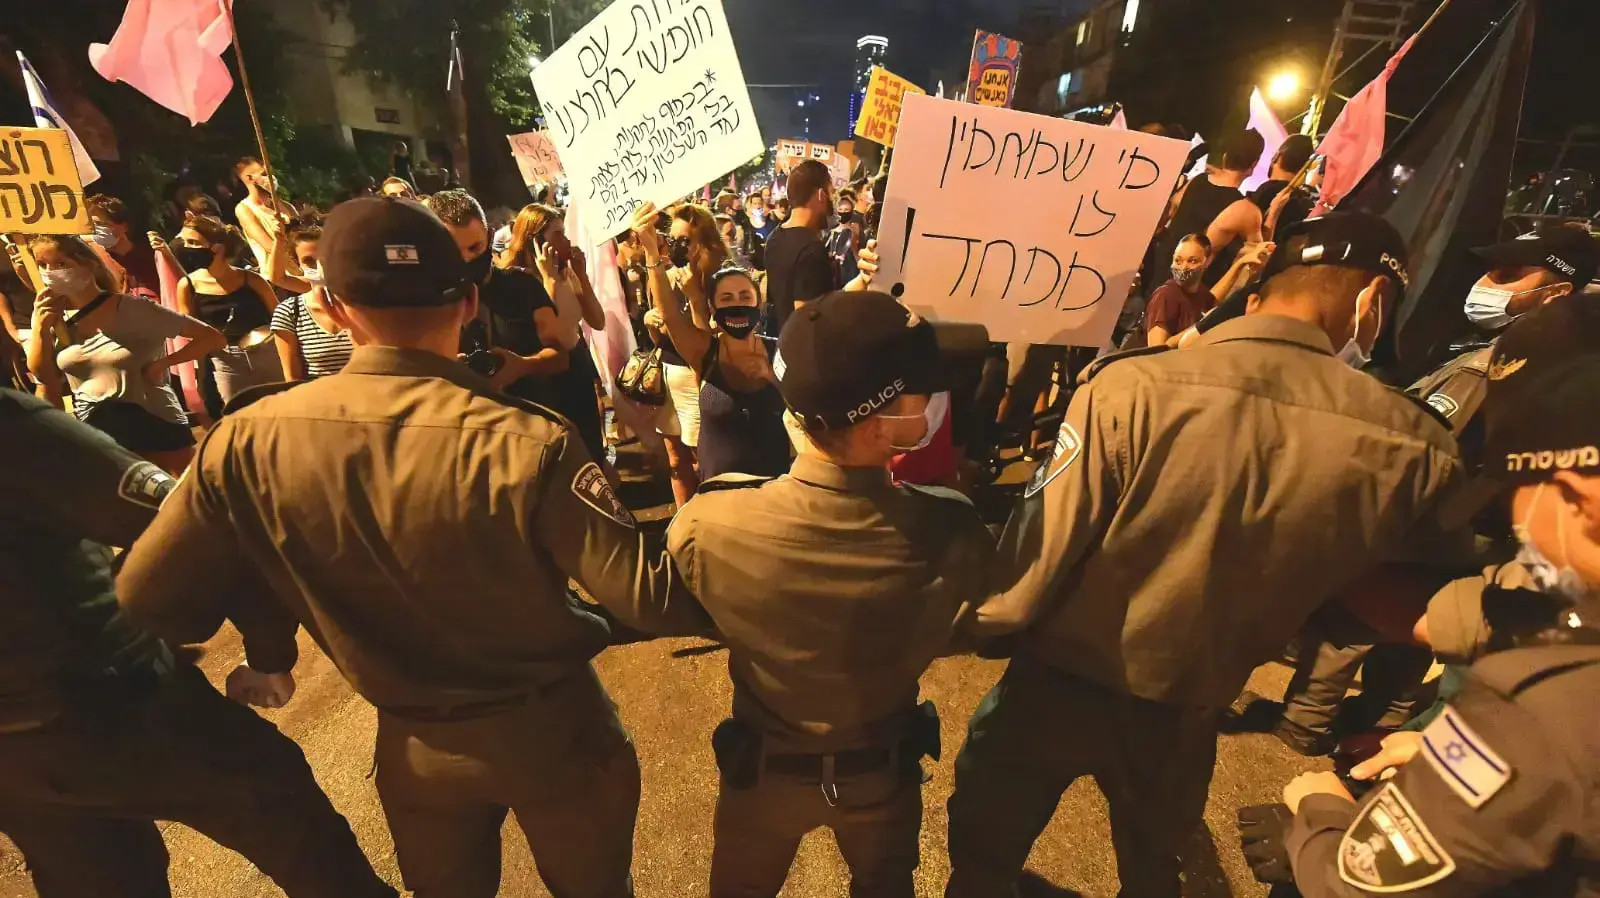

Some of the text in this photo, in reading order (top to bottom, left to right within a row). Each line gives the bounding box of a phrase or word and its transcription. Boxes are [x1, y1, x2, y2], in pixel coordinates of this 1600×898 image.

[578, 25, 609, 78] עם
[637, 5, 713, 74] חופשי
[940, 115, 1160, 189] מי שמאמין
[1546, 254, 1576, 276] משטרה
[847, 379, 905, 423] POLICE
[1506, 445, 1600, 472] משטרה
